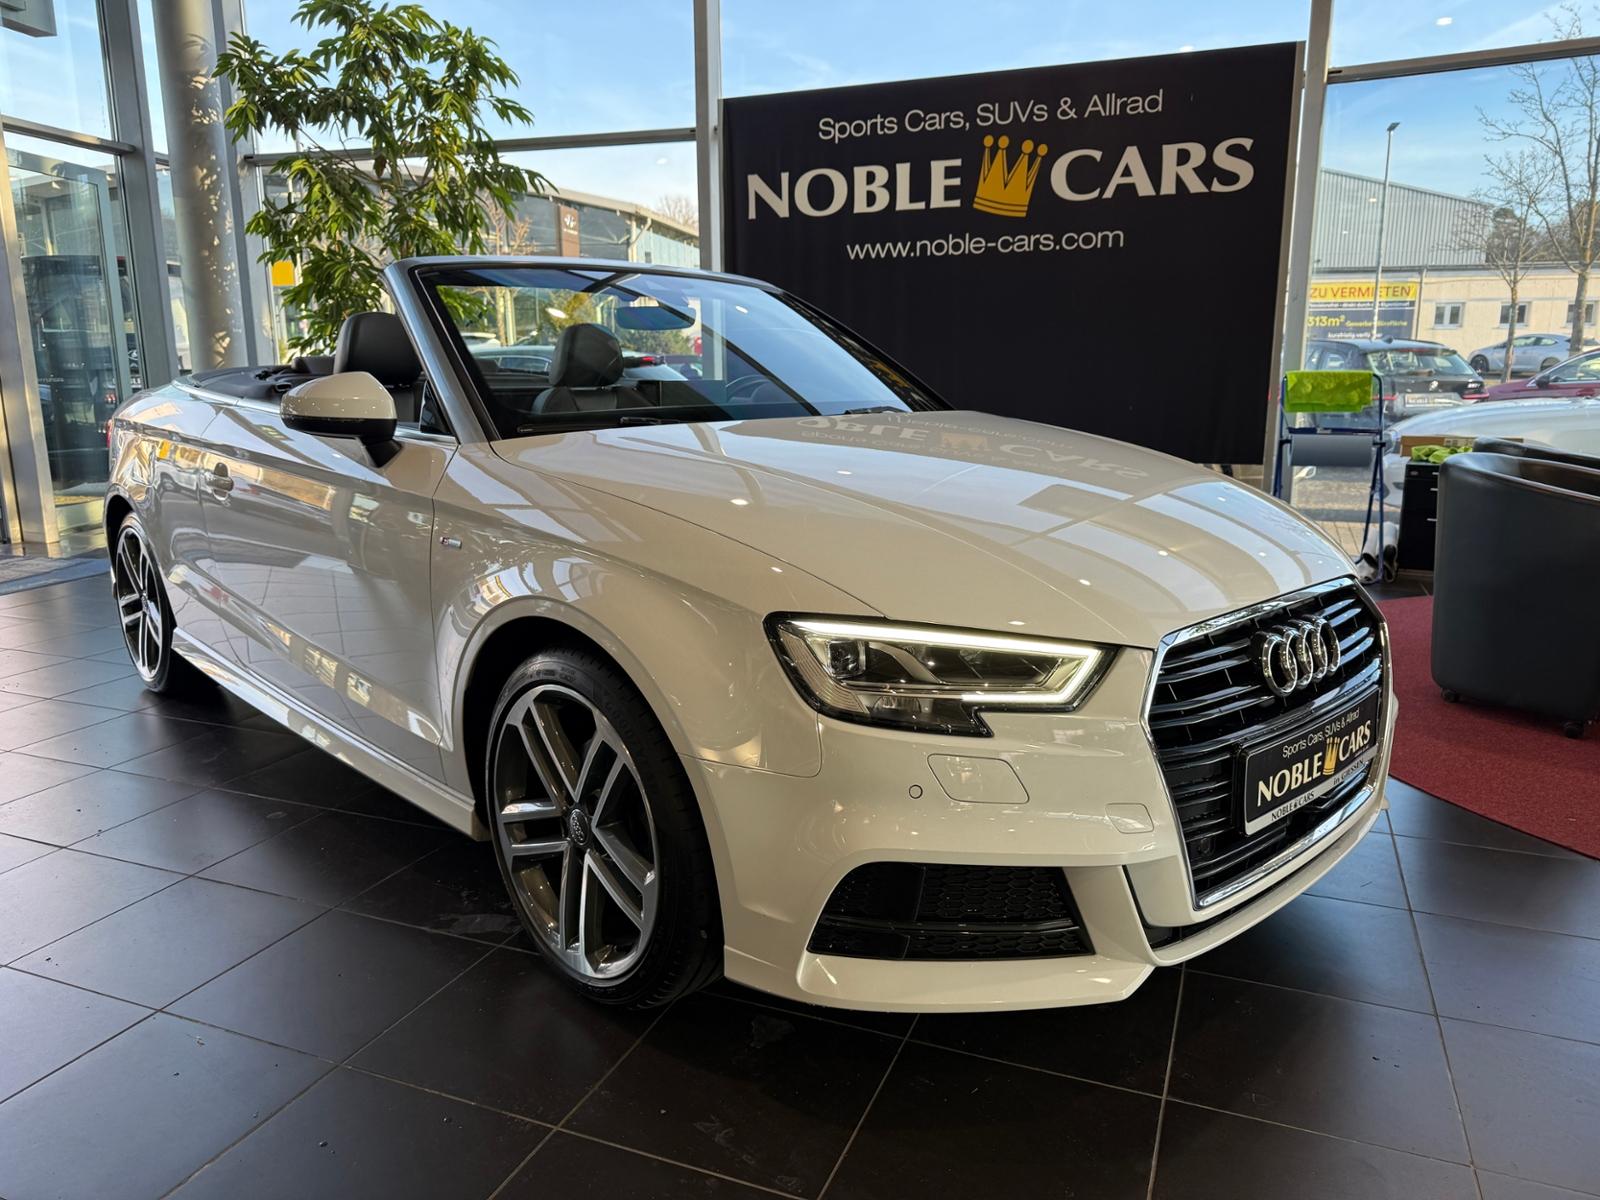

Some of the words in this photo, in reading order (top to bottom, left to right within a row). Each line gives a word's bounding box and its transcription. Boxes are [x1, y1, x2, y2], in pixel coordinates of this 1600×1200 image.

[818, 114, 898, 144] Sports
[904, 109, 970, 132] Cars,
[976, 99, 1048, 126] SUVs
[1057, 97, 1077, 120] &
[1084, 88, 1163, 118] Allrad
[747, 158, 962, 220] NOBLE
[1050, 137, 1254, 201] CARS
[846, 230, 1124, 260] www.noble-cars.com
[1310, 287, 1327, 298] ZU
[1257, 752, 1323, 807] NOBLE
[1338, 719, 1371, 762] CARS
[1282, 738, 1307, 758] Sports
